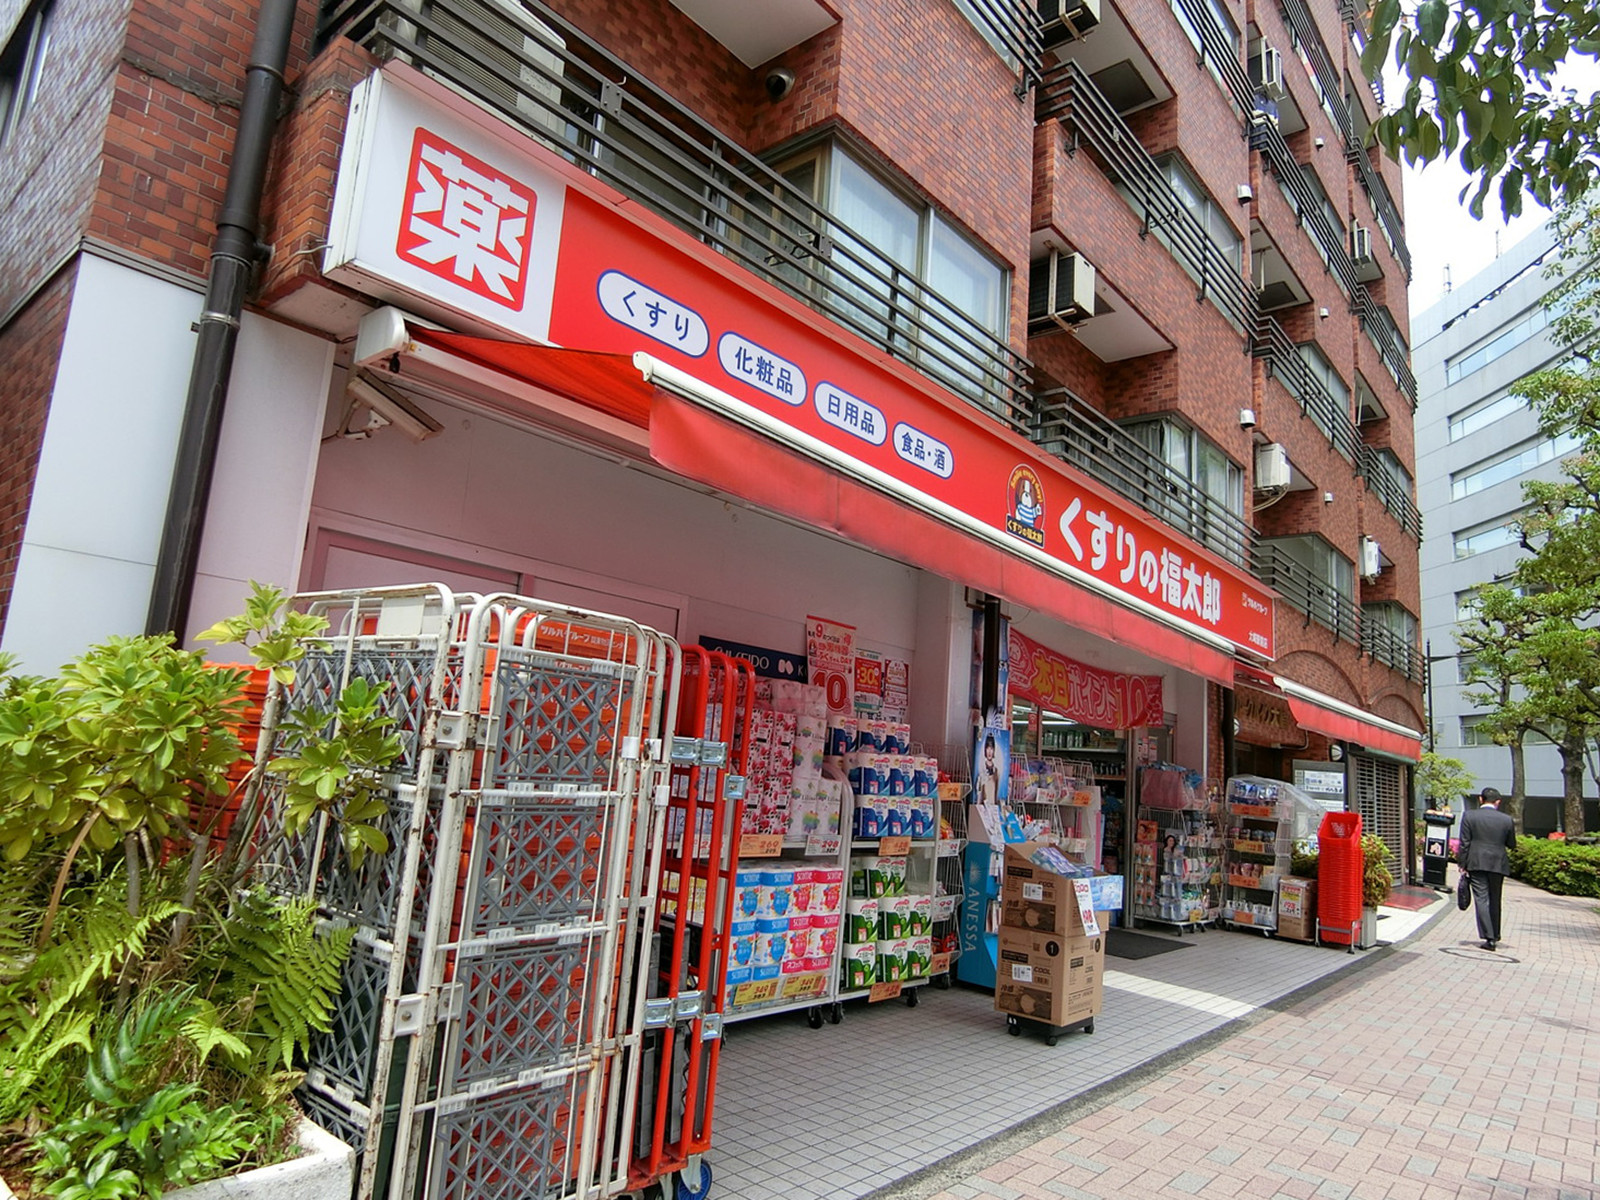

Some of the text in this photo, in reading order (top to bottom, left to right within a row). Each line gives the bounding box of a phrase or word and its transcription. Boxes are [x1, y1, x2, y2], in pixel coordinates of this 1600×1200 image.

[407, 144, 530, 302] 薬
[619, 289, 691, 343] くすり
[733, 347, 795, 396] 化粧品
[826, 392, 876, 436] 日用品
[1007, 519, 1043, 544] くすりの福太郎
[1058, 496, 1221, 626] くすりの福太郎
[964, 887, 980, 951] ANESSA
